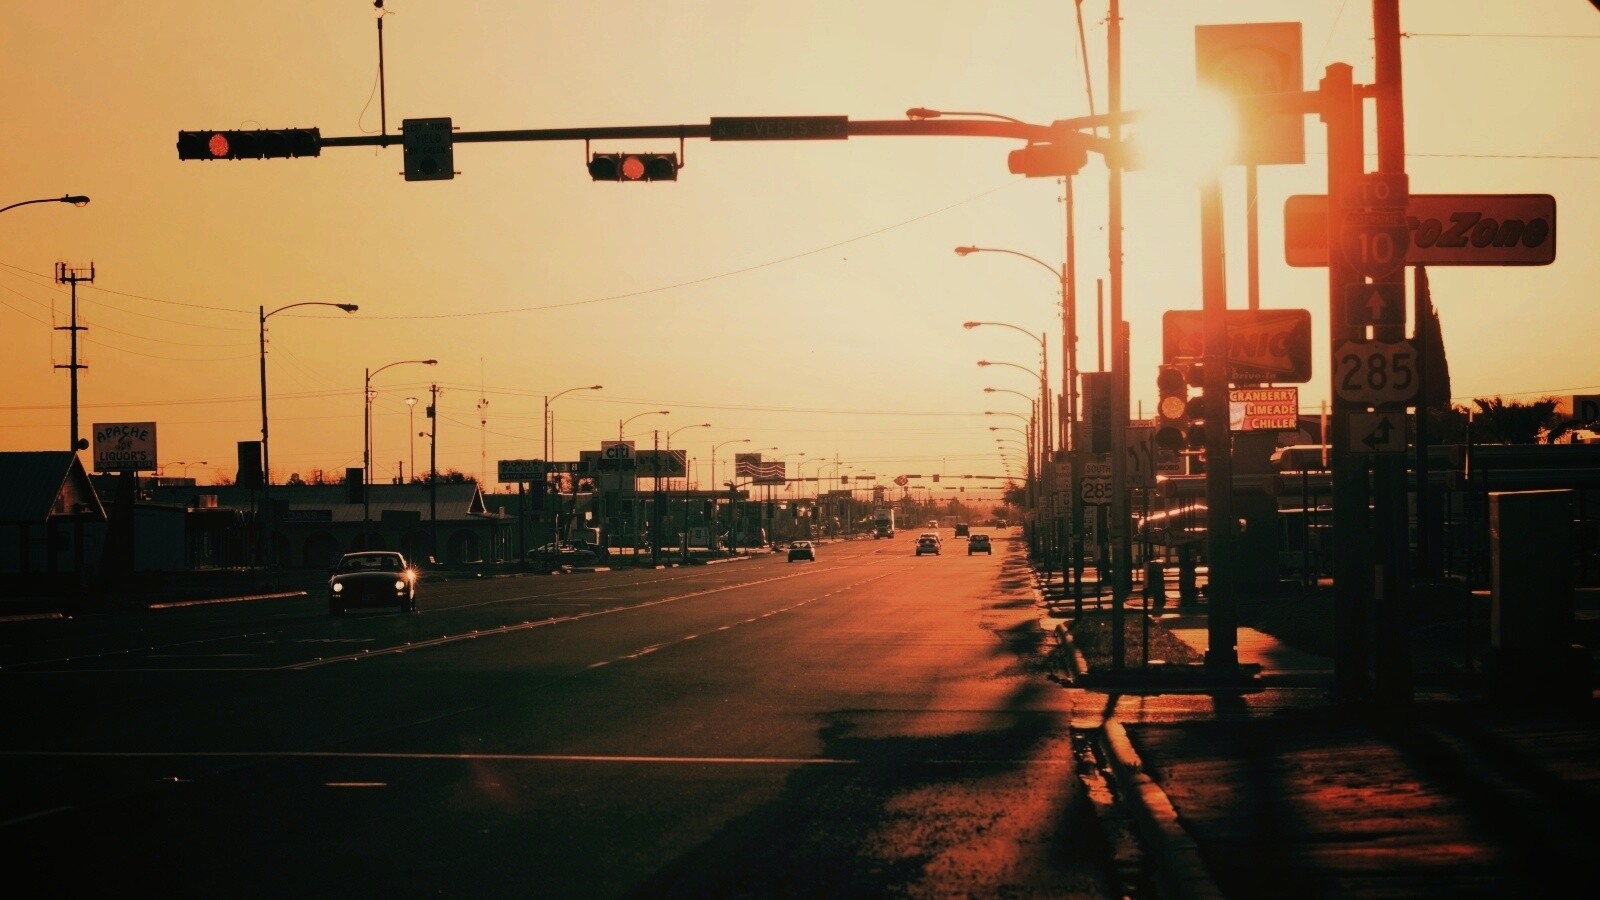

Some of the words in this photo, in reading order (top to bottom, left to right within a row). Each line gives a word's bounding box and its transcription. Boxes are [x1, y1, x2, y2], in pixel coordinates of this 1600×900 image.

[414, 133, 442, 144] YIELD
[1361, 182, 1390, 199] TO
[1359, 232, 1393, 264] 10
[1178, 331, 1292, 359] SNIC
[1341, 353, 1412, 391] 285
[1229, 390, 1295, 402] CRANBERRY
[1247, 403, 1295, 416] LIMEADE
[1251, 417, 1296, 430] CHILLER
[97, 425, 149, 443] APACHE
[1086, 464, 1111, 473] SOUTH
[1084, 483, 1112, 498] 285
